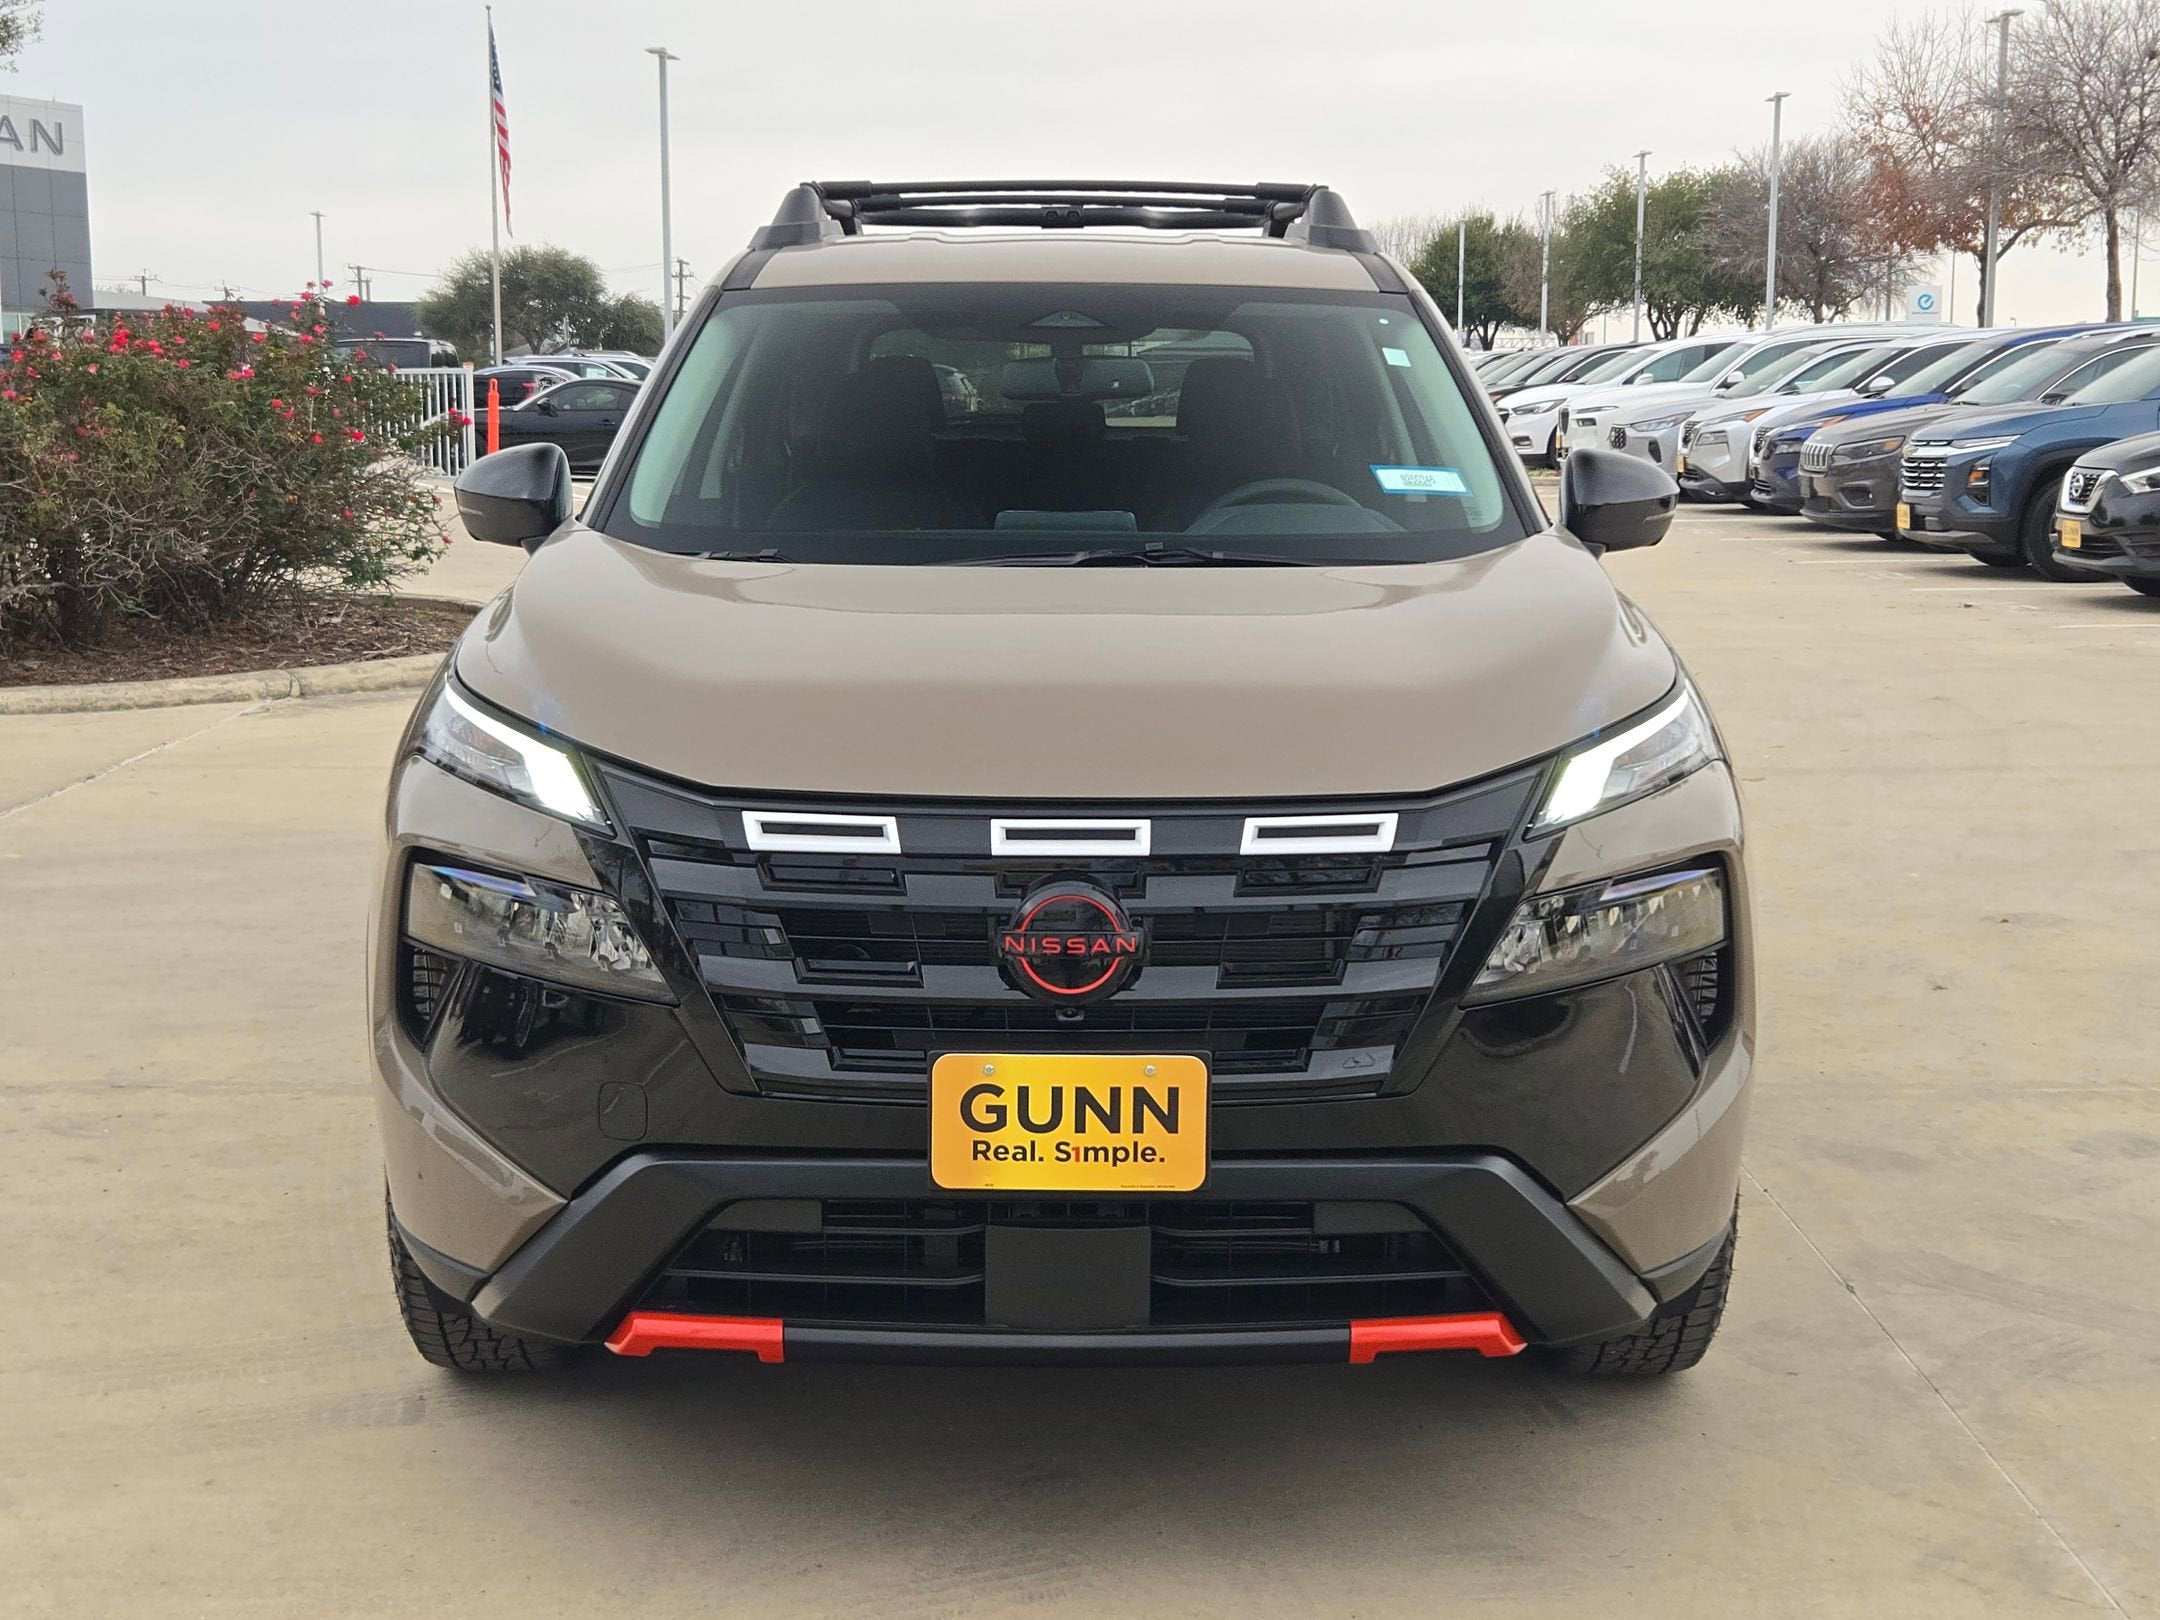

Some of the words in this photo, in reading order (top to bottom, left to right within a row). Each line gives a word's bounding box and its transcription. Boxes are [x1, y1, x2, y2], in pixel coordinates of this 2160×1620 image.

[1003, 934, 1137, 956] NISSAN
[959, 1083, 1180, 1135] GUNN
[972, 1140, 1044, 1163] Real.
